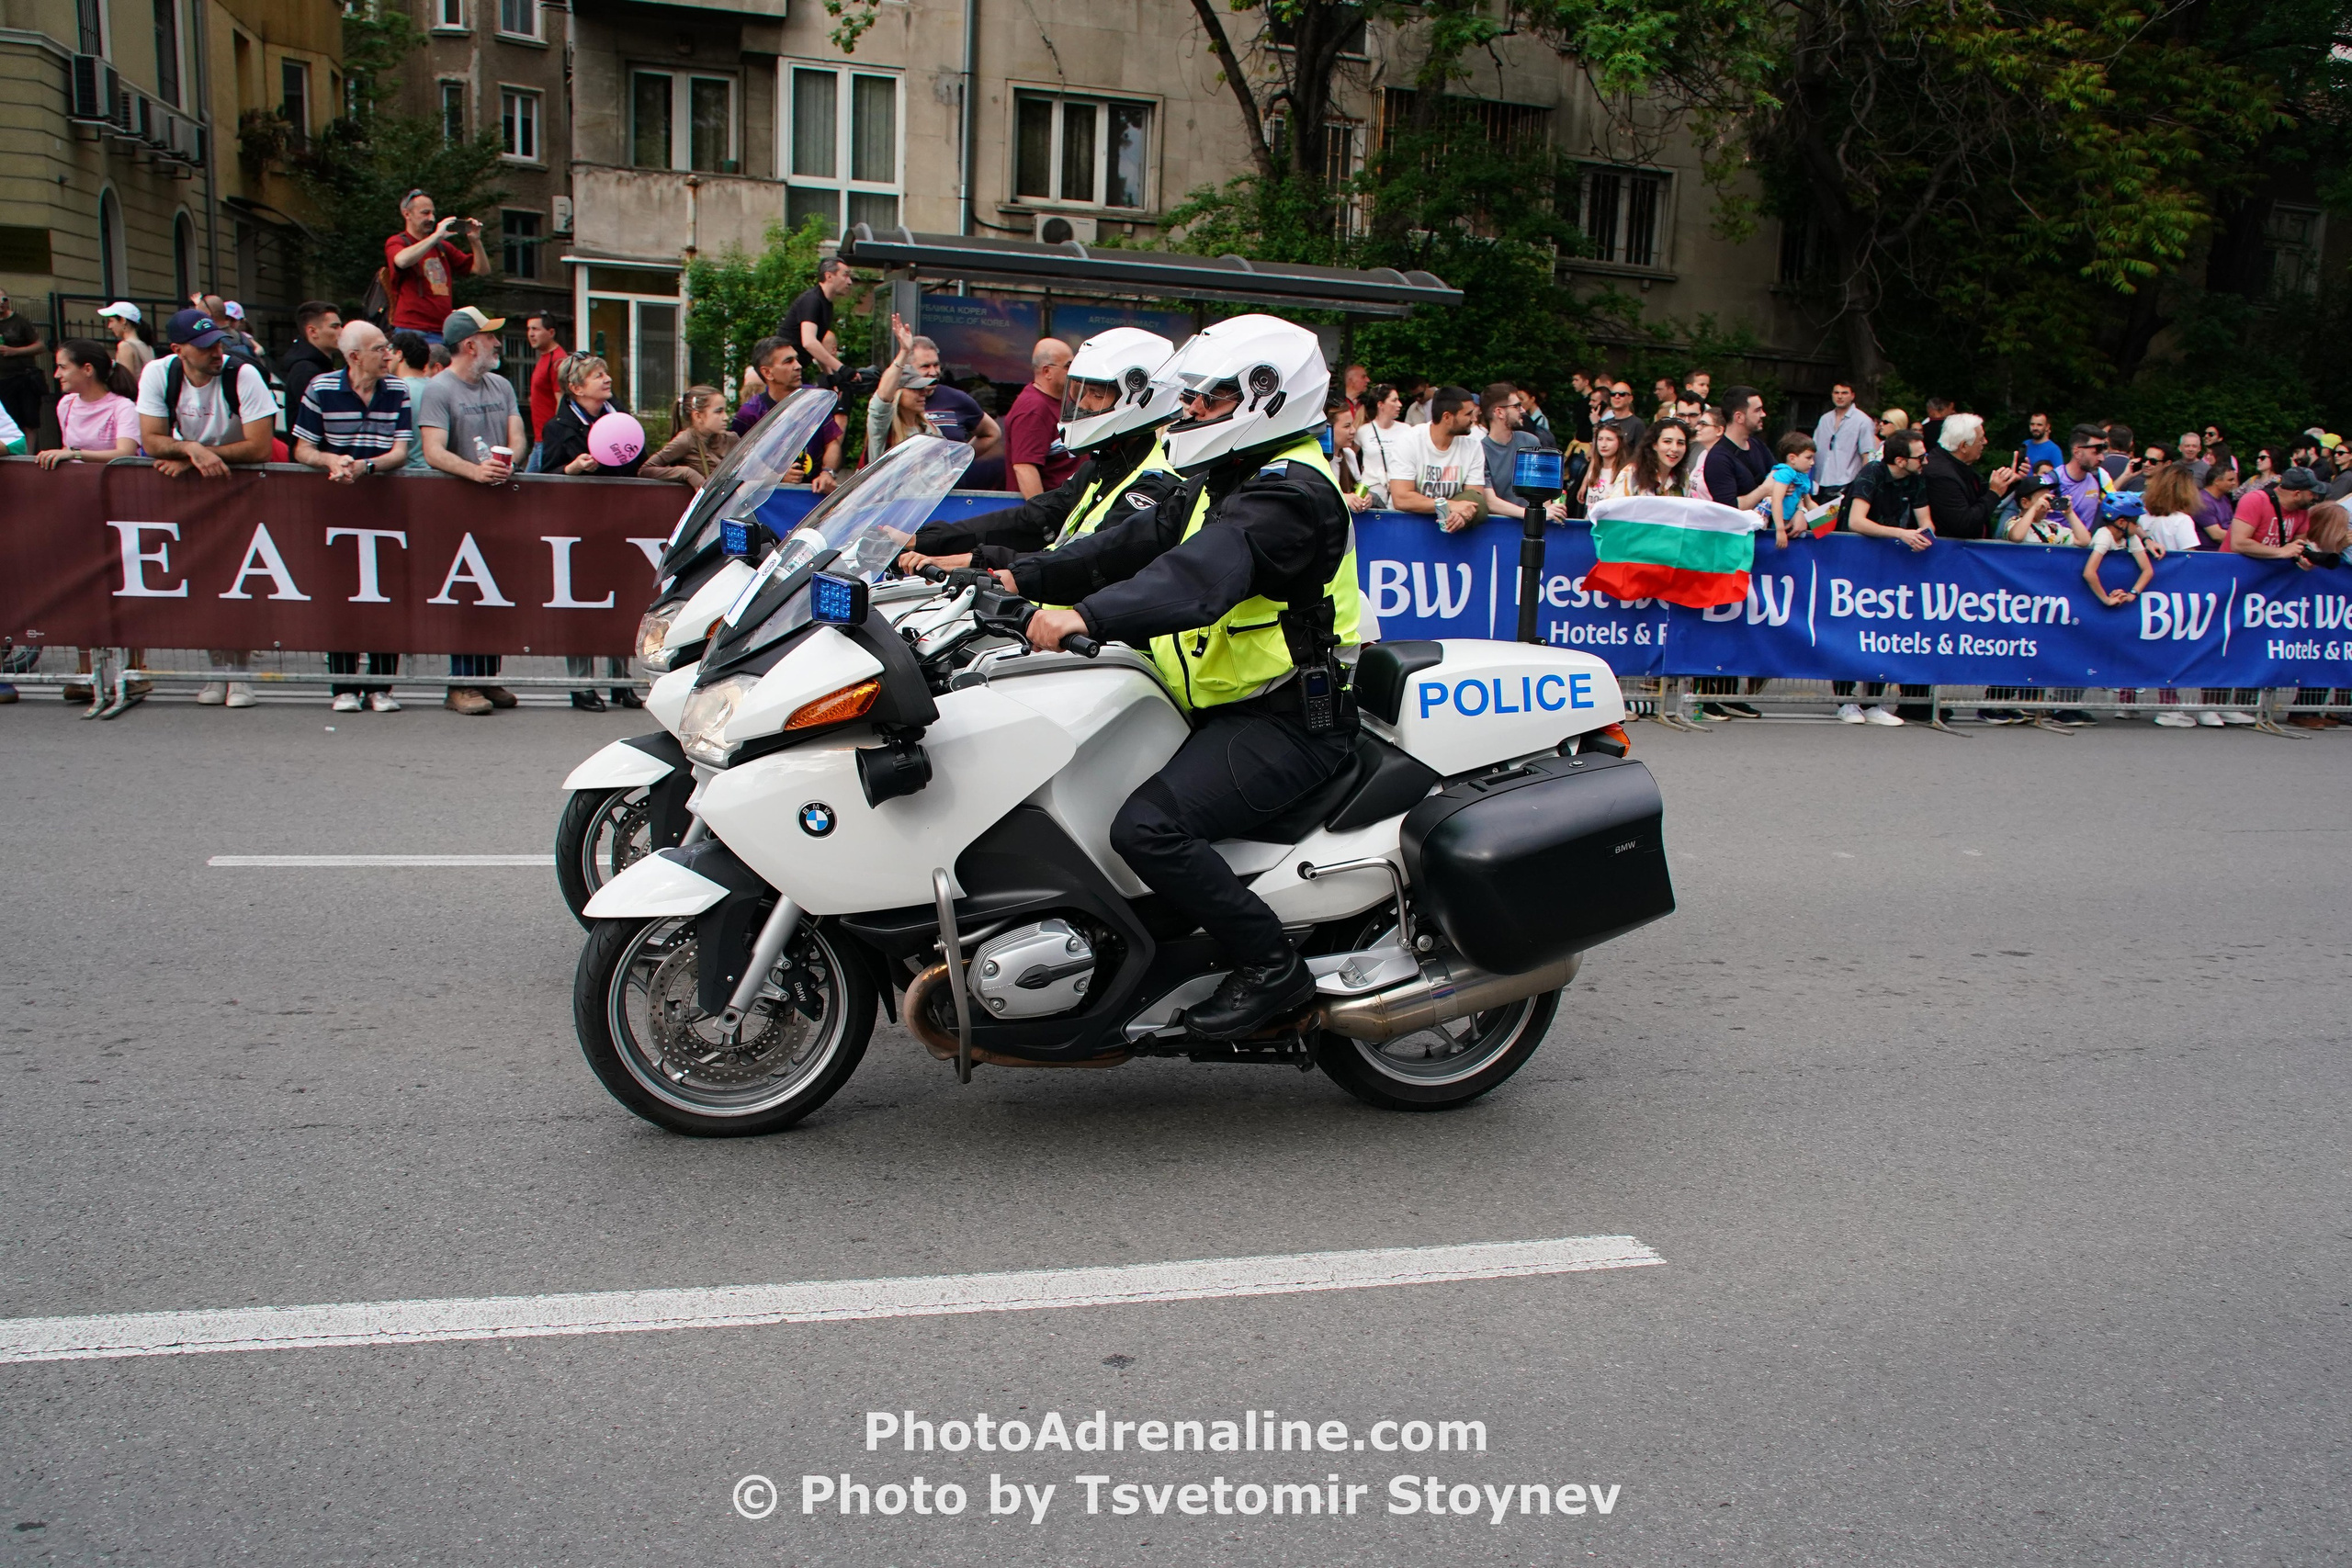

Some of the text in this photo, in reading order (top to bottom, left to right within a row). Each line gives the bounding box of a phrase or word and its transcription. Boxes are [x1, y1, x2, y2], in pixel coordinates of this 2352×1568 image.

[957, 306, 988, 315] КОРЕЯ
[967, 317, 978, 325] OF
[980, 318, 1010, 327] KOREA
[1369, 559, 1472, 619] BW
[1830, 579, 1914, 620] Best
[2140, 591, 2217, 641] BW
[2244, 592, 2310, 629] Best
[1550, 621, 1628, 645] Hotels
[1634, 623, 1651, 646] &
[1860, 630, 2038, 657] Hotels & Resorts
[2267, 639, 2321, 660] Hotels
[2324, 640, 2340, 660] &
[1419, 673, 1594, 718] POLICE
[802, 804, 831, 816] BMW
[1615, 840, 1636, 854] BMW
[794, 981, 808, 1001] BMW
